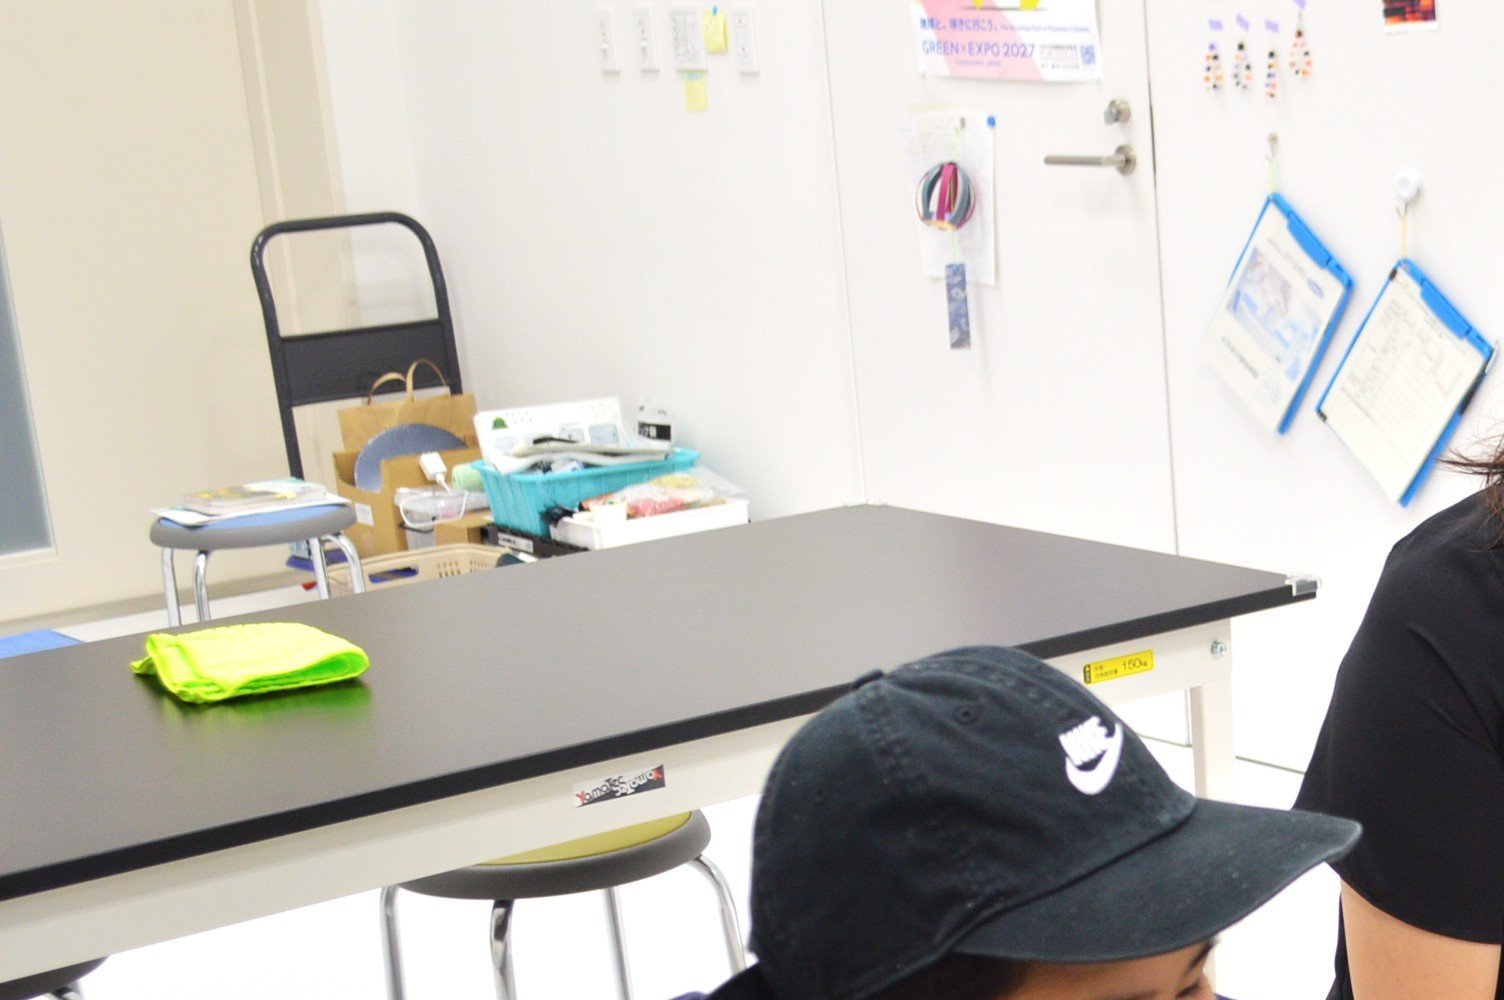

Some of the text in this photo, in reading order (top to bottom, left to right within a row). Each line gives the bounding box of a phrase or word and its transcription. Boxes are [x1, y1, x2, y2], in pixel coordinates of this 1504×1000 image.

[922, 41, 959, 56] GREEN
[968, 42, 1001, 57] EXPO
[1003, 43, 1035, 58] 2027
